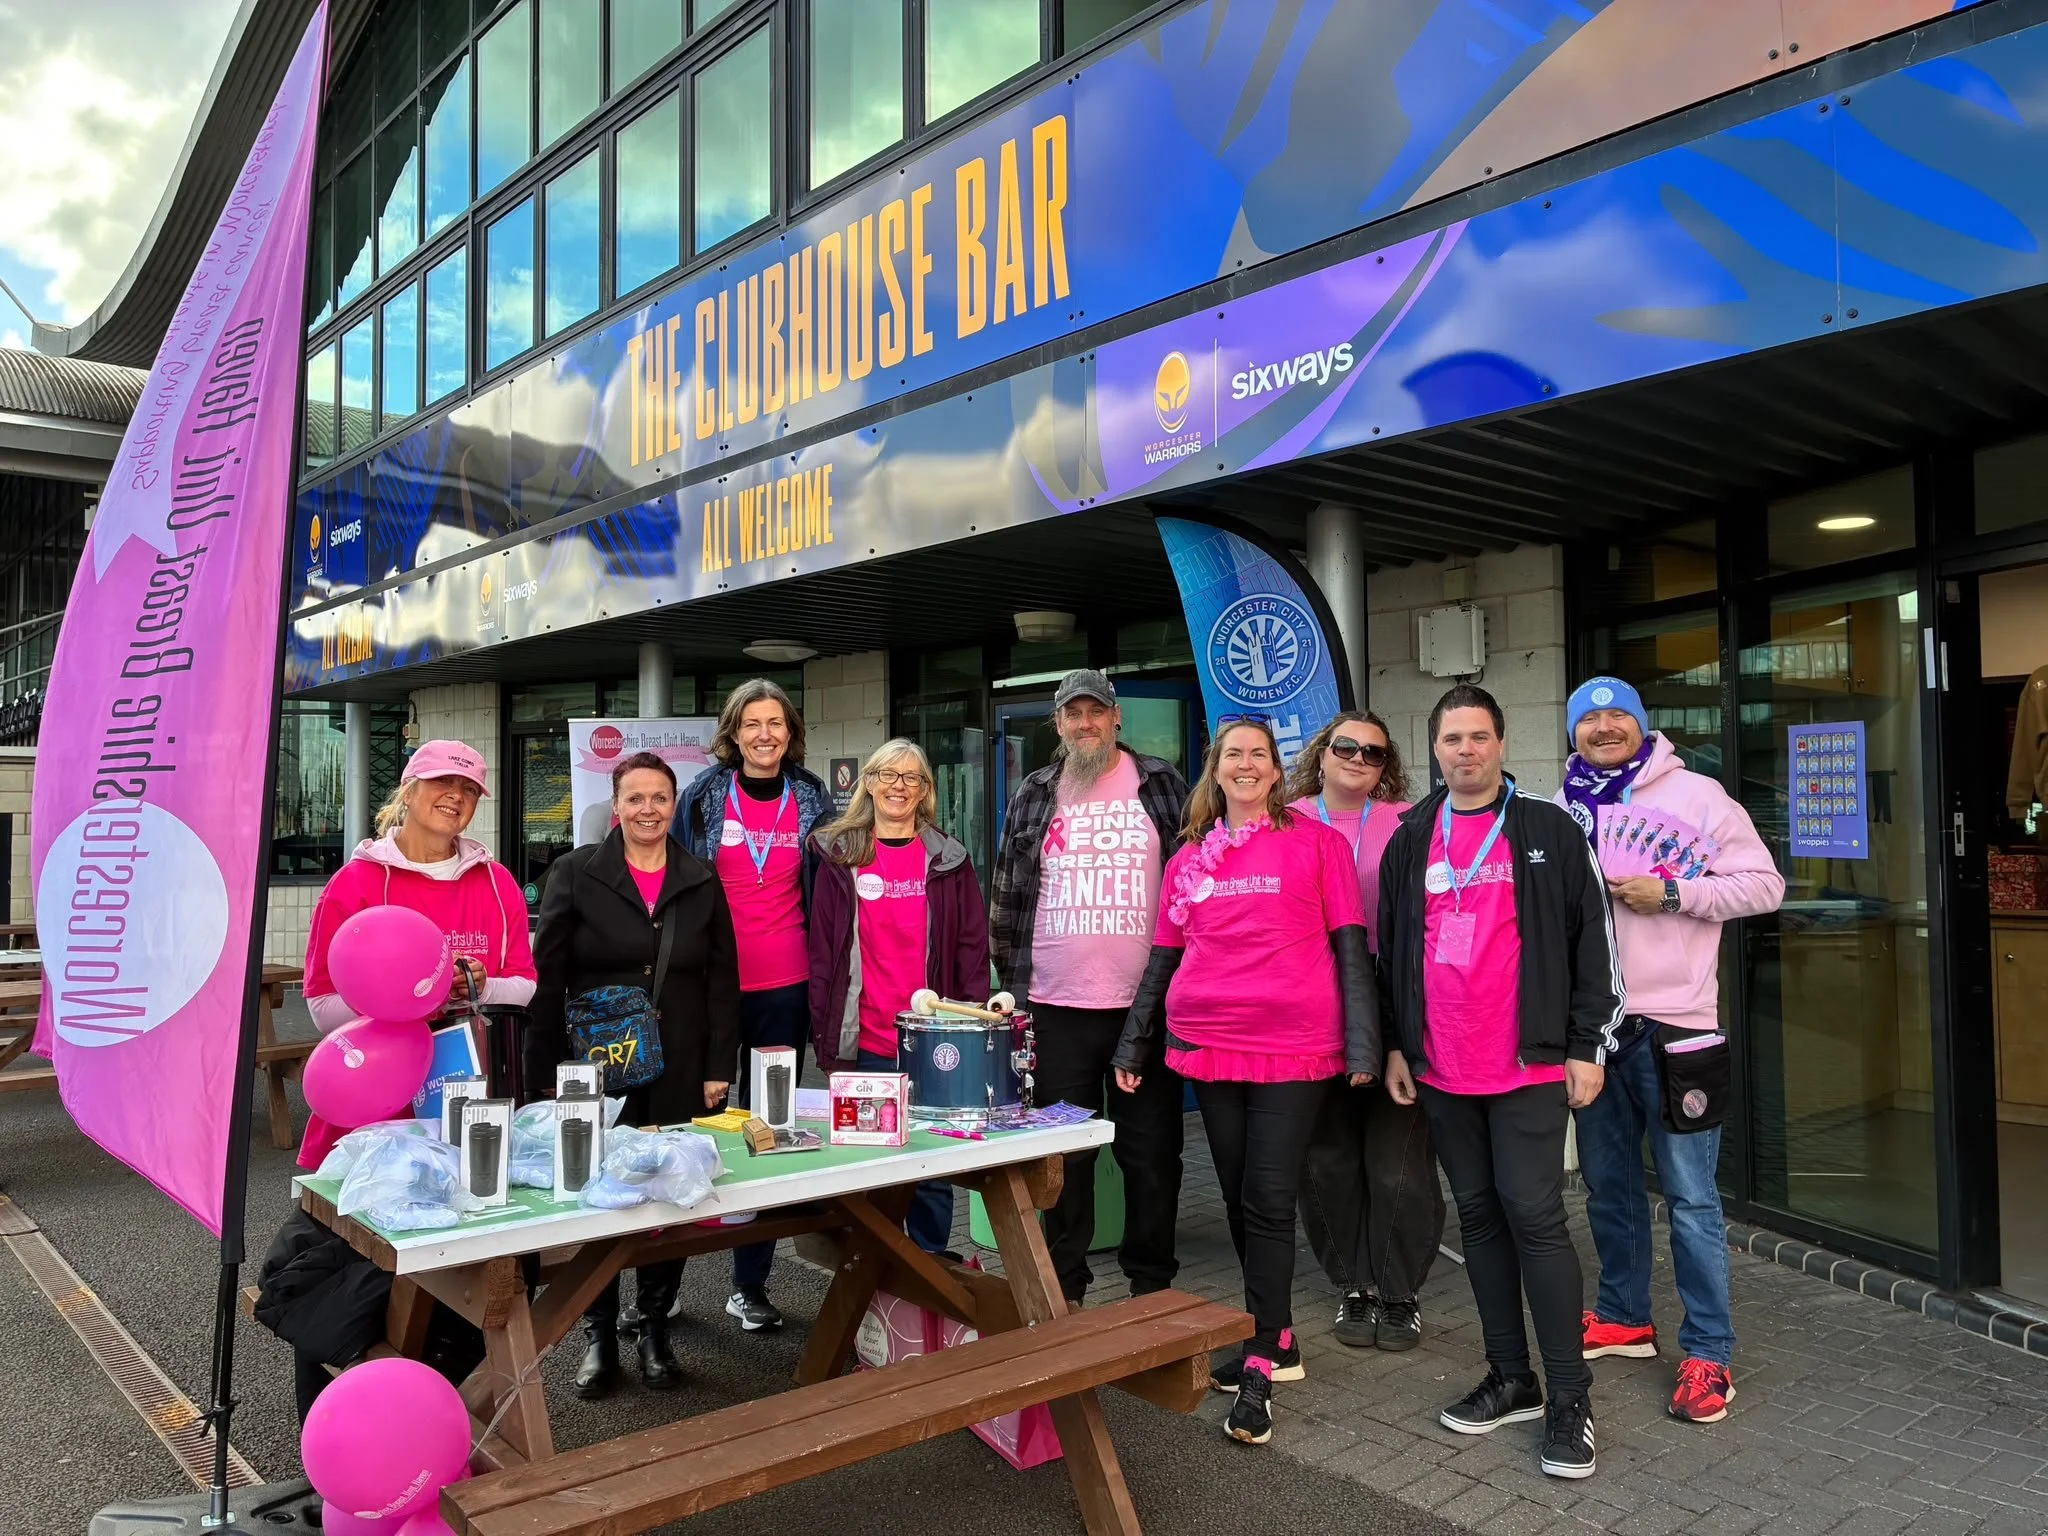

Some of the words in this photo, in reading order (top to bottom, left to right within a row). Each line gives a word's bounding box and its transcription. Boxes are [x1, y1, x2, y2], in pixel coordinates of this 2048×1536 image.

[627, 314, 681, 467] THE
[695, 183, 934, 441] CLUBHOUSE
[956, 115, 1070, 339] BAR
[1231, 342, 1354, 400] sixways
[1144, 431, 1202, 452] WORCESTER
[1144, 441, 1202, 465] WARRIORS
[702, 495, 731, 574] ALL
[739, 463, 833, 563] WELCOME
[331, 519, 361, 547] sixways
[504, 580, 538, 602] sixways
[1216, 601, 1278, 645] WORCESTER
[1281, 606, 1307, 630] CITY
[1302, 639, 1312, 648] 21
[1215, 656, 1226, 666] 20
[1238, 685, 1284, 700] WOMEN
[1285, 674, 1304, 691] F.C.
[641, 732, 662, 749] Breast
[664, 732, 678, 748] Unit
[680, 732, 700, 748] Haven
[1062, 799, 1147, 817] WEAR
[1070, 814, 1148, 832] PINK
[1069, 830, 1149, 850] FOR
[1045, 853, 1148, 872] BREAST
[1046, 869, 1147, 908] CANCER
[1045, 910, 1147, 936] AWARENESS
[588, 1027, 638, 1077] CR7
[762, 1053, 781, 1067] CUP
[557, 1067, 579, 1081] CUP
[444, 1083, 467, 1099] CUP
[463, 1108, 488, 1125] CUP
[555, 1104, 580, 1121] CUP
